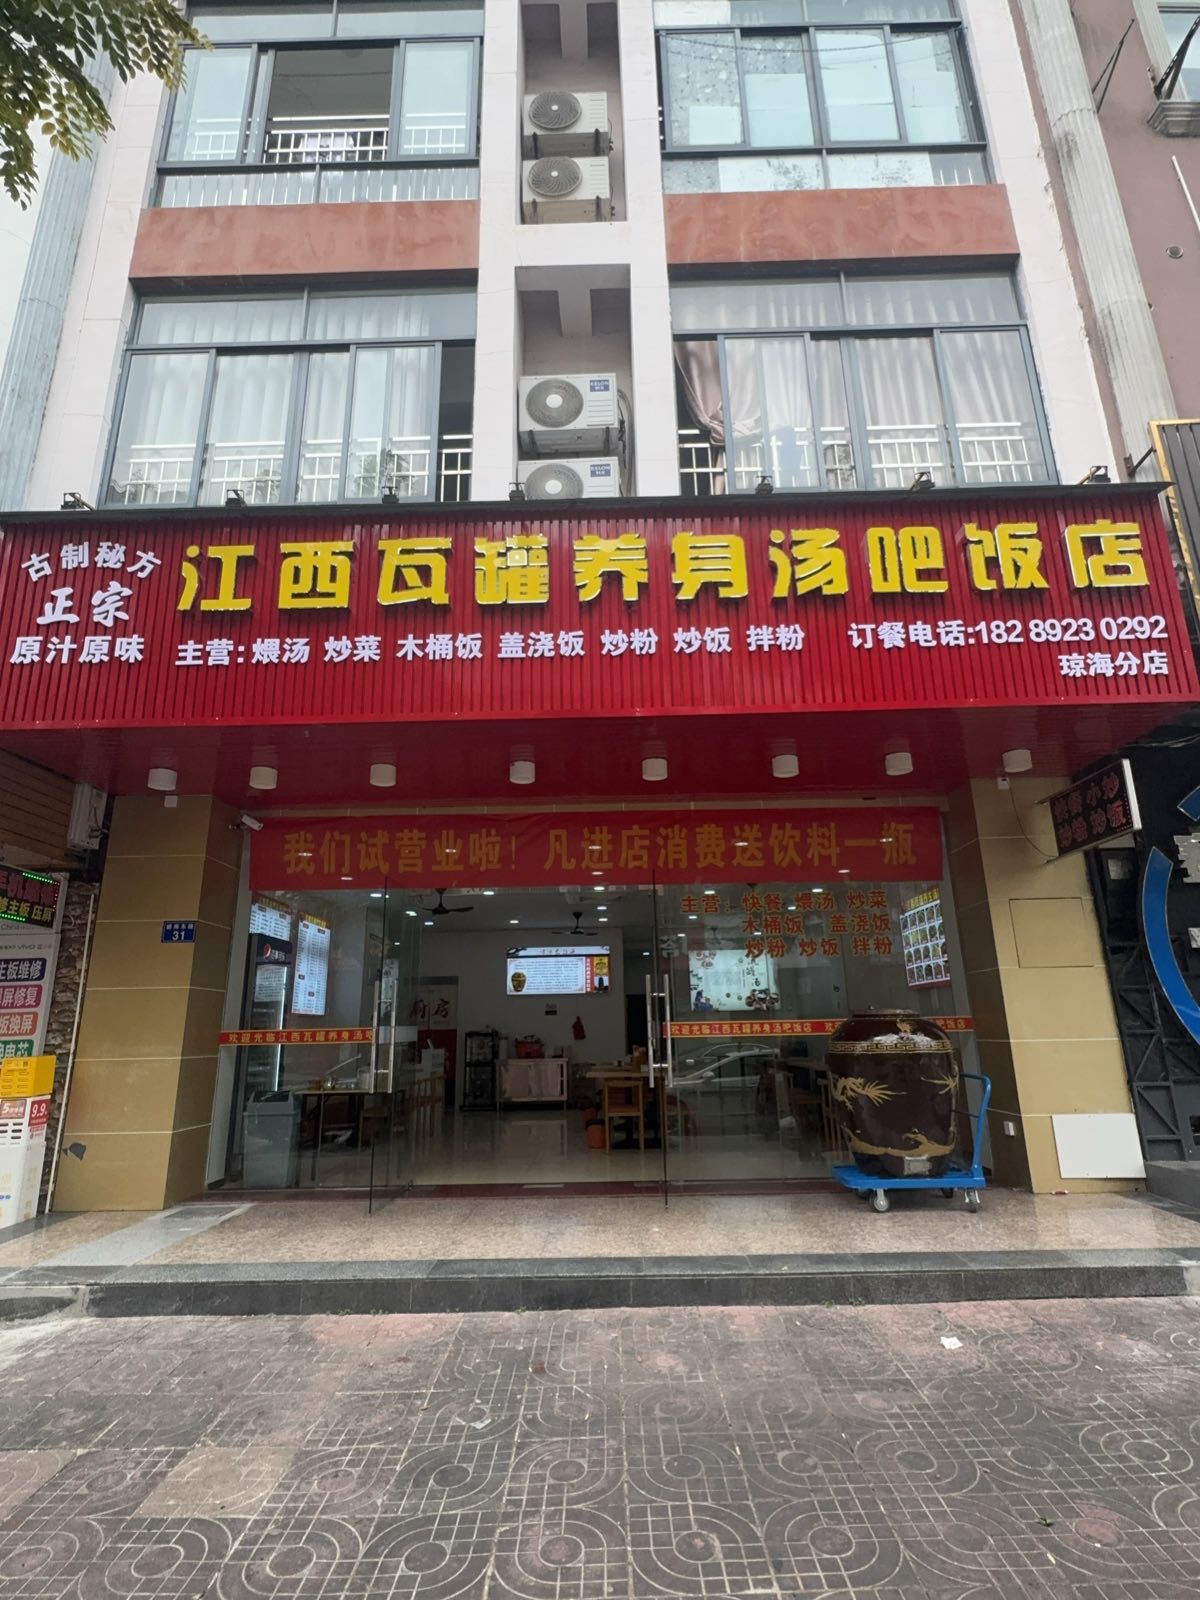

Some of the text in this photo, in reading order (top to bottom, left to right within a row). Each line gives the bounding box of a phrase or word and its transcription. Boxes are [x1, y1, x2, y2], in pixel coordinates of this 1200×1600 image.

[21, 541, 162, 582] 古制秘方
[177, 520, 1149, 612] 江西瓦罐养身汤吧饭店
[37, 581, 133, 628] 正宗
[324, 635, 382, 663] 炒菜
[397, 632, 483, 661] 木桶饭
[497, 631, 586, 658] 盖浇饭
[601, 628, 658, 656] 炒粉
[674, 626, 732, 654] 炒饭
[747, 624, 805, 652] 拌粉
[1029, 617, 1095, 643] 8923
[1100, 615, 1168, 641] 0292
[10, 634, 145, 665] 原汁原味
[1058, 650, 1169, 678] 琼海分店
[543, 822, 917, 871] 凡进店消费送饮料一瓶
[794, 892, 834, 912] 煨汤
[847, 890, 887, 909] 炒菜
[172, 931, 185, 940] 31
[742, 914, 891, 934] 木桶饭 盖浇饭
[744, 936, 892, 958] 炒粉 炒饭 拌粉
